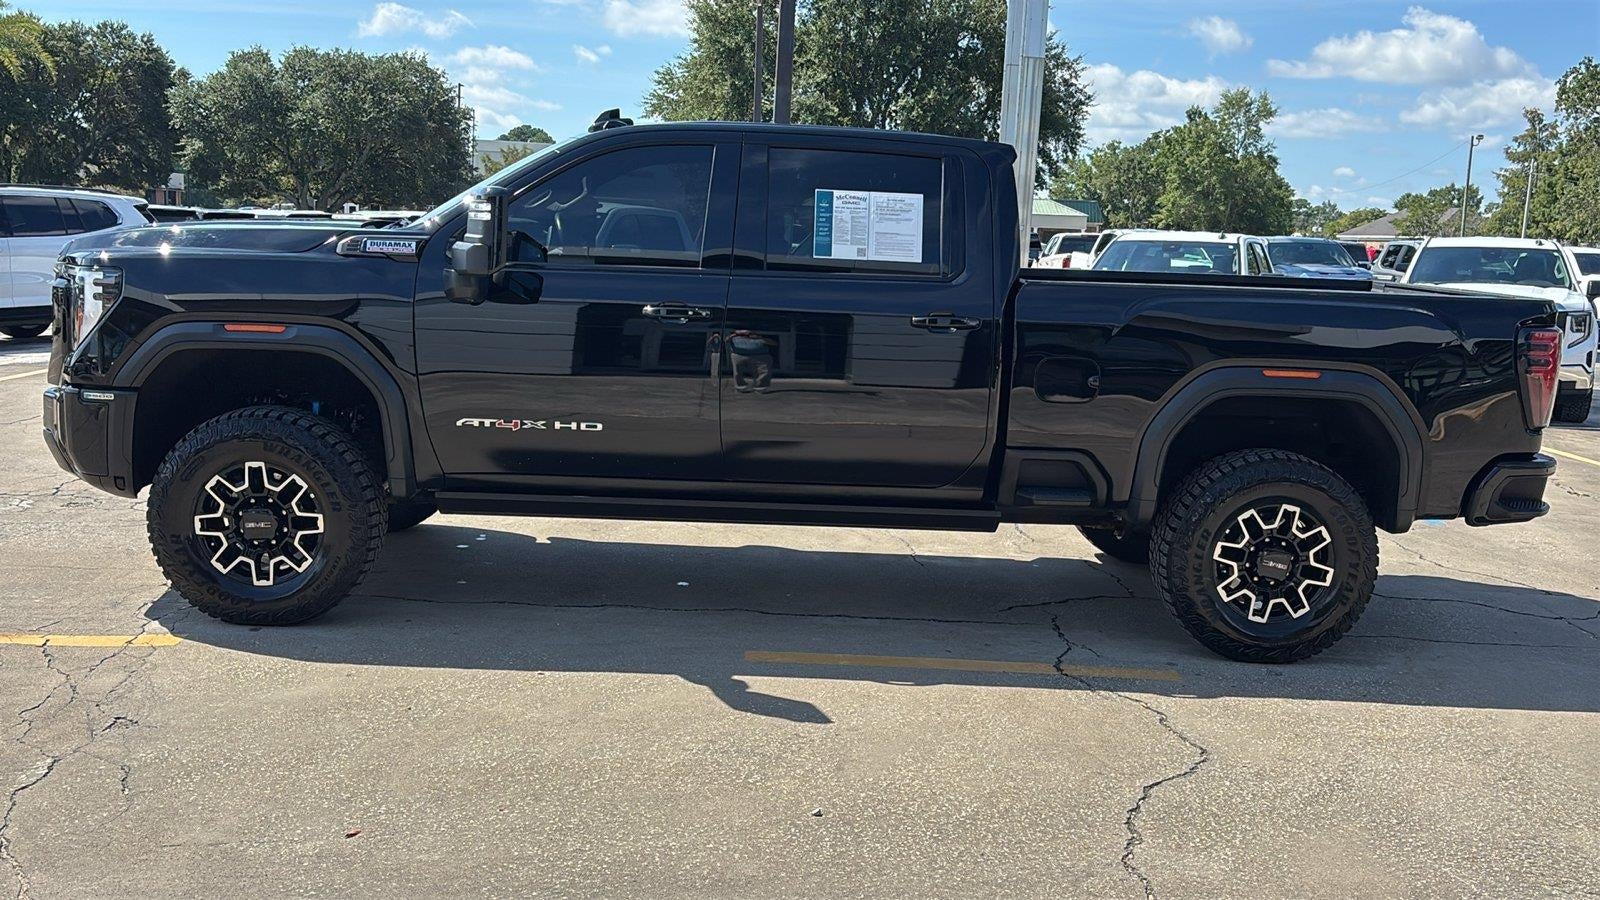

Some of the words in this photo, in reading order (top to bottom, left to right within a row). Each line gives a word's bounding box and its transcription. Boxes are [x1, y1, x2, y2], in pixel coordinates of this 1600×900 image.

[836, 194, 868, 202] McConnell
[456, 417, 547, 431] AT4X
[554, 420, 603, 432] HD
